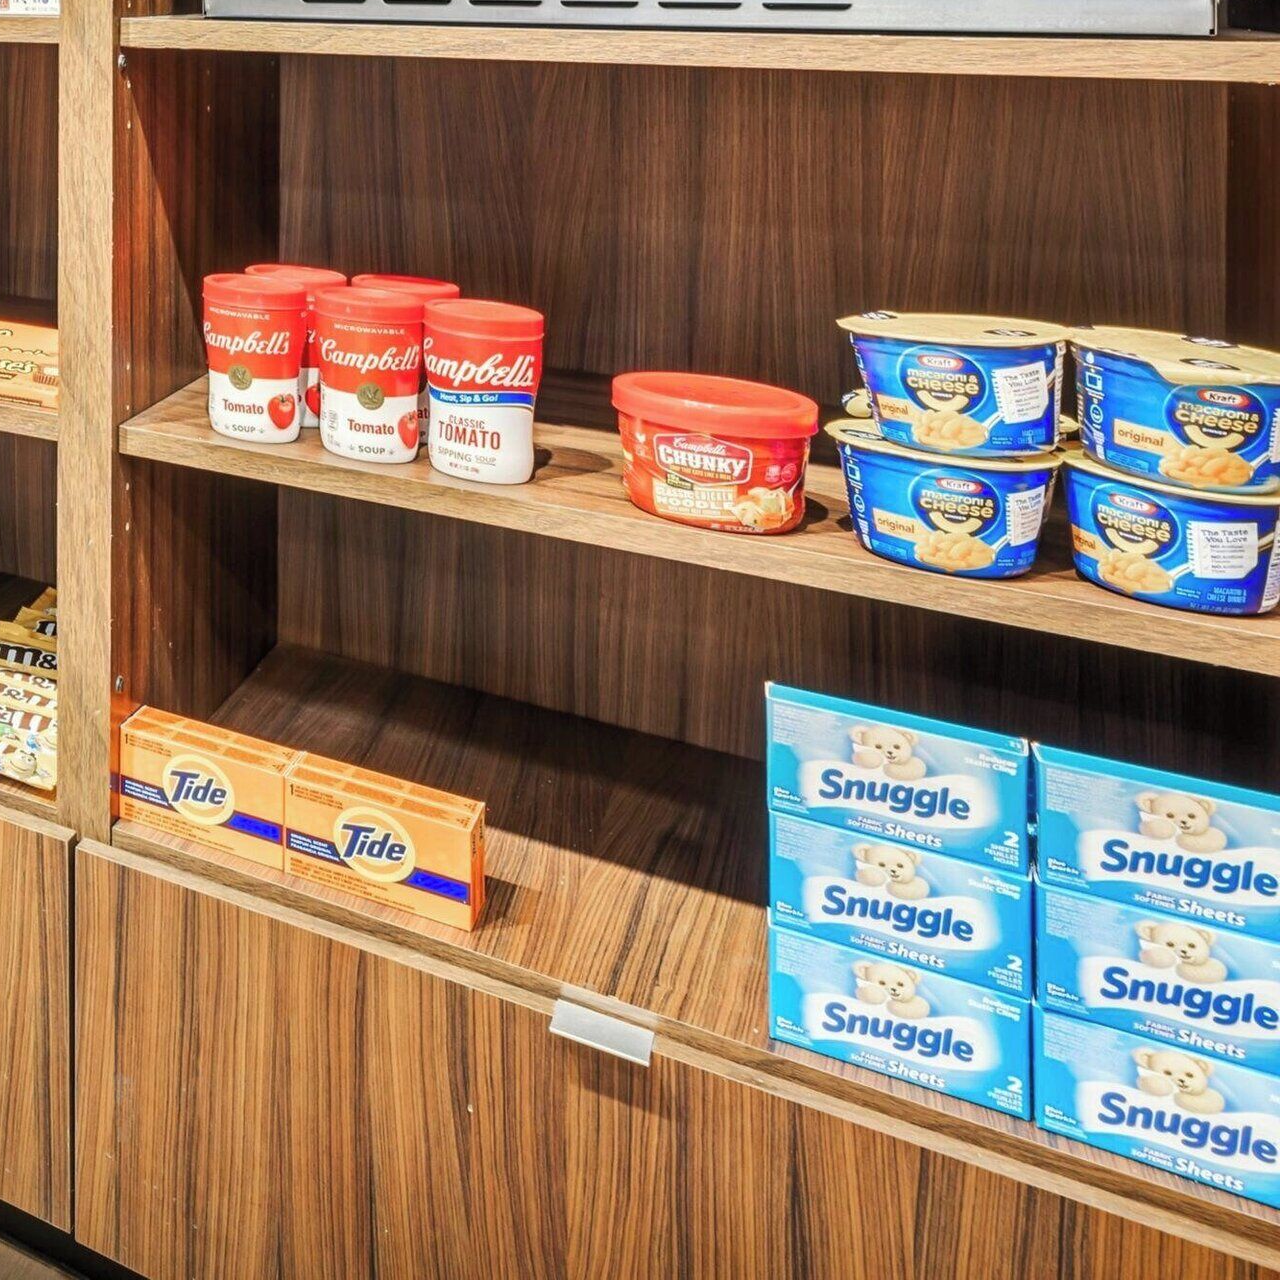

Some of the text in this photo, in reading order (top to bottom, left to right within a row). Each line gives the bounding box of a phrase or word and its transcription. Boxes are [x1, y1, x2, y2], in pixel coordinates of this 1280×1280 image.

[209, 307, 271, 322] MICROWAVABLE
[333, 322, 406, 336] MICROWAVABLE
[204, 322, 290, 358] Campbell's
[320, 339, 420, 375] Campbell's
[423, 336, 535, 389] Campbell's
[925, 357, 953, 368] Kraft
[906, 368, 979, 384] macaroni &
[221, 397, 265, 416] Tomato
[439, 392, 500, 405] Heat, Sip & Go!
[1209, 392, 1237, 404] Kraft
[231, 424, 257, 434] SOUP
[347, 418, 396, 437] Tomato
[448, 414, 486, 431] CLASSIC
[438, 421, 502, 451] TOMATO
[1117, 428, 1165, 447] original
[358, 445, 387, 456] SOUP
[437, 445, 497, 467] SIPPING SOUP
[657, 443, 747, 477] CHUNKY
[945, 480, 971, 491] Kraft
[922, 490, 994, 508] macaroni &
[1116, 496, 1145, 510] Kraft
[877, 517, 916, 534] original
[169, 770, 228, 807] Tide
[818, 768, 971, 821] Snuggle
[847, 819, 943, 848] SOFTENER Sheets
[1004, 831, 1020, 847] 2
[340, 823, 407, 864] Tide
[1099, 838, 1280, 897] Snuggle
[821, 884, 974, 942] Snuggle
[849, 935, 946, 968] SOFTENER Sheets
[1006, 954, 1023, 971] 2
[1099, 966, 1280, 1030] Snuggle
[821, 1001, 974, 1062] Snuggle
[1006, 1076, 1023, 1092] 2
[1097, 1091, 1278, 1164] Snuggle
